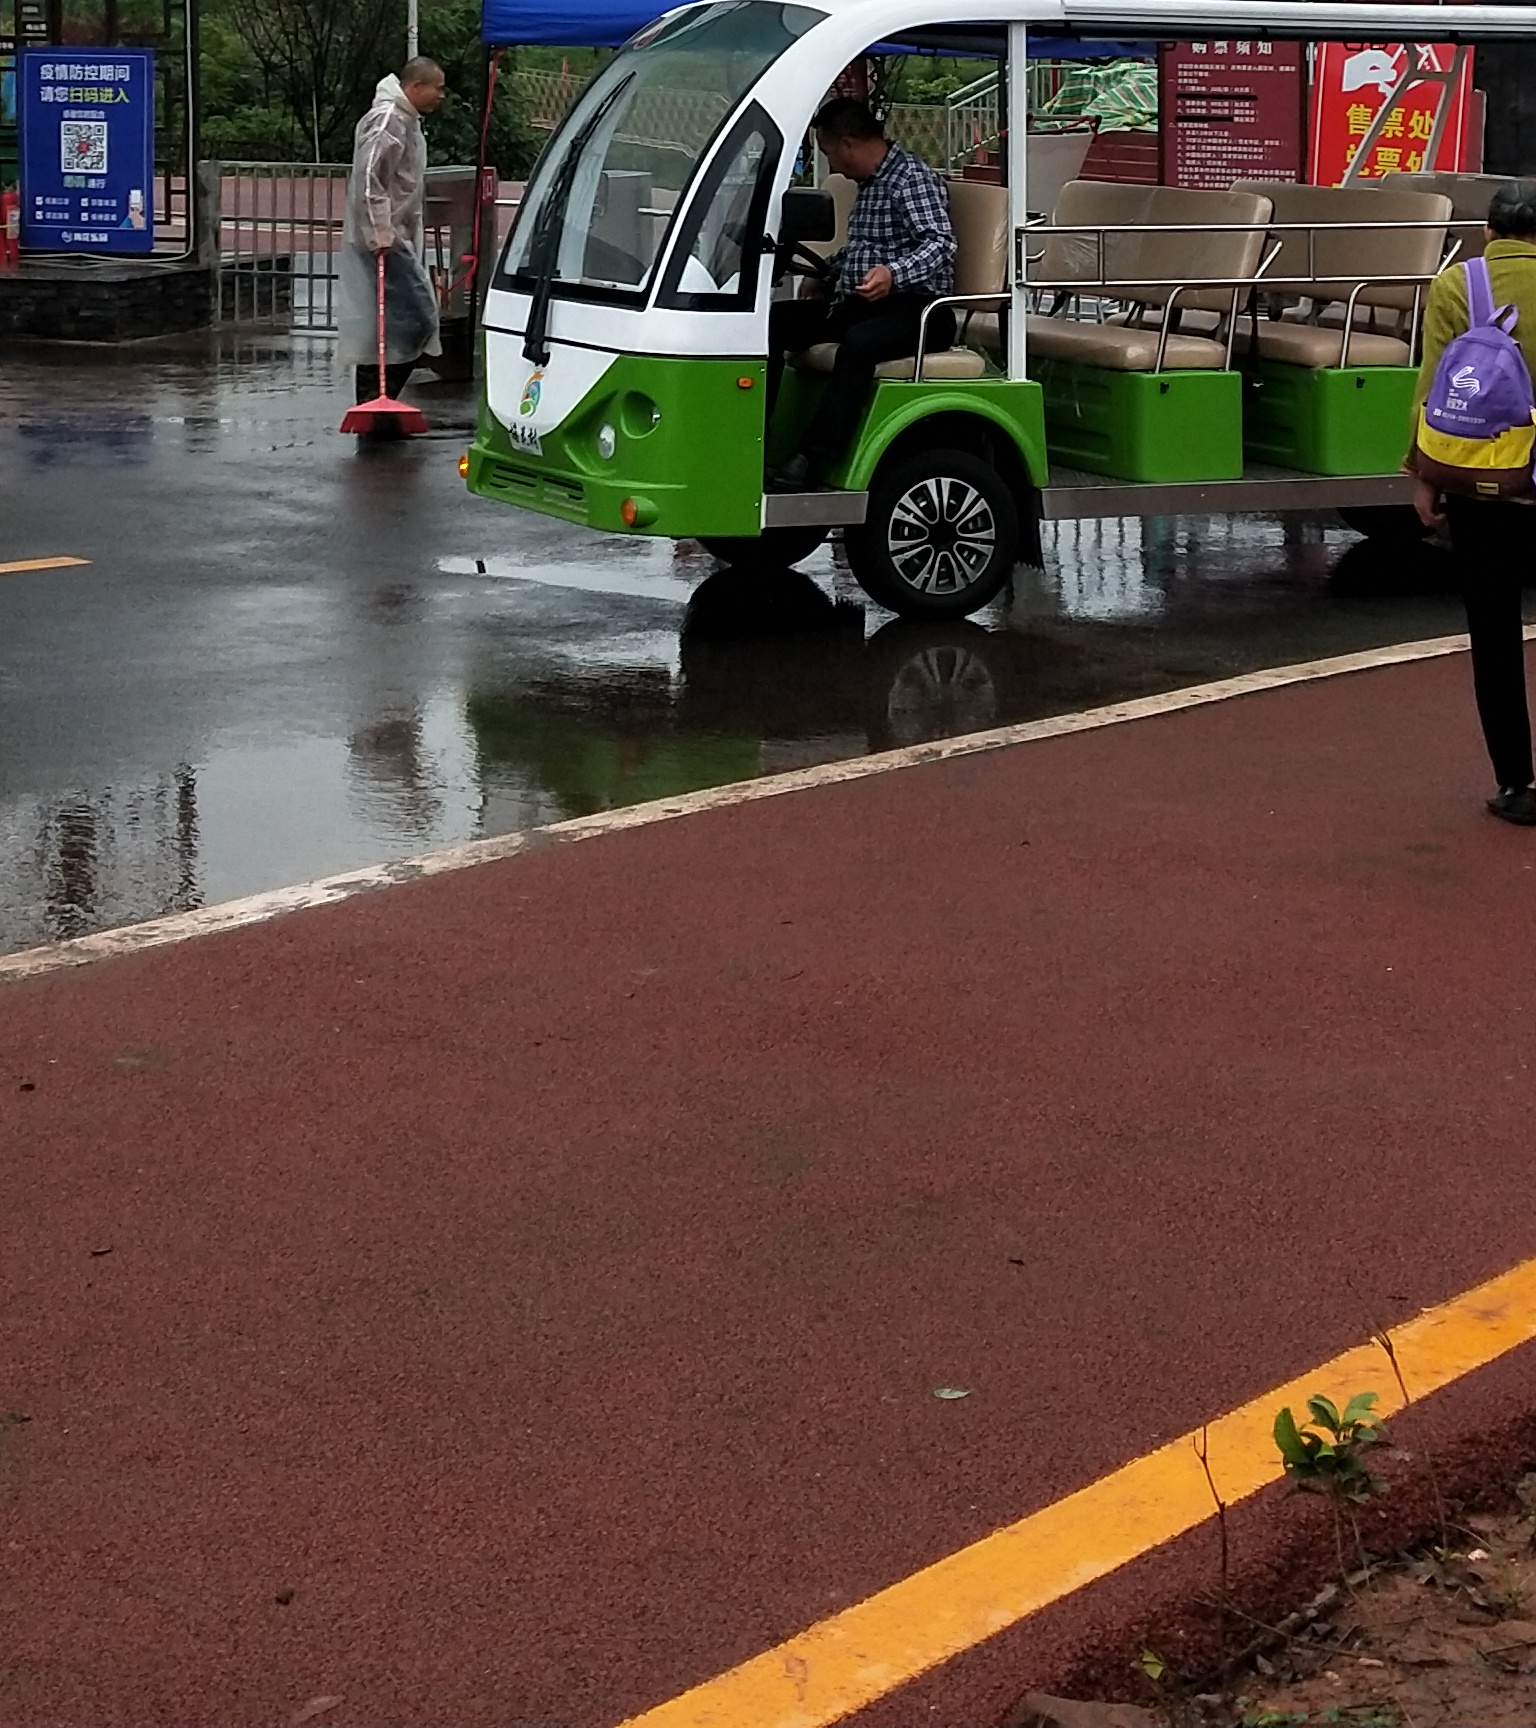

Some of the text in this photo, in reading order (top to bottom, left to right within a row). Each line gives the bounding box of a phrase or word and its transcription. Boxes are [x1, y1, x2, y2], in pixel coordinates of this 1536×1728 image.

[1191, 40, 1273, 55] 购票须知
[40, 64, 130, 81] 疫情防控期间
[40, 86, 130, 103] 请您扫码进入
[1346, 103, 1434, 140] 售票处
